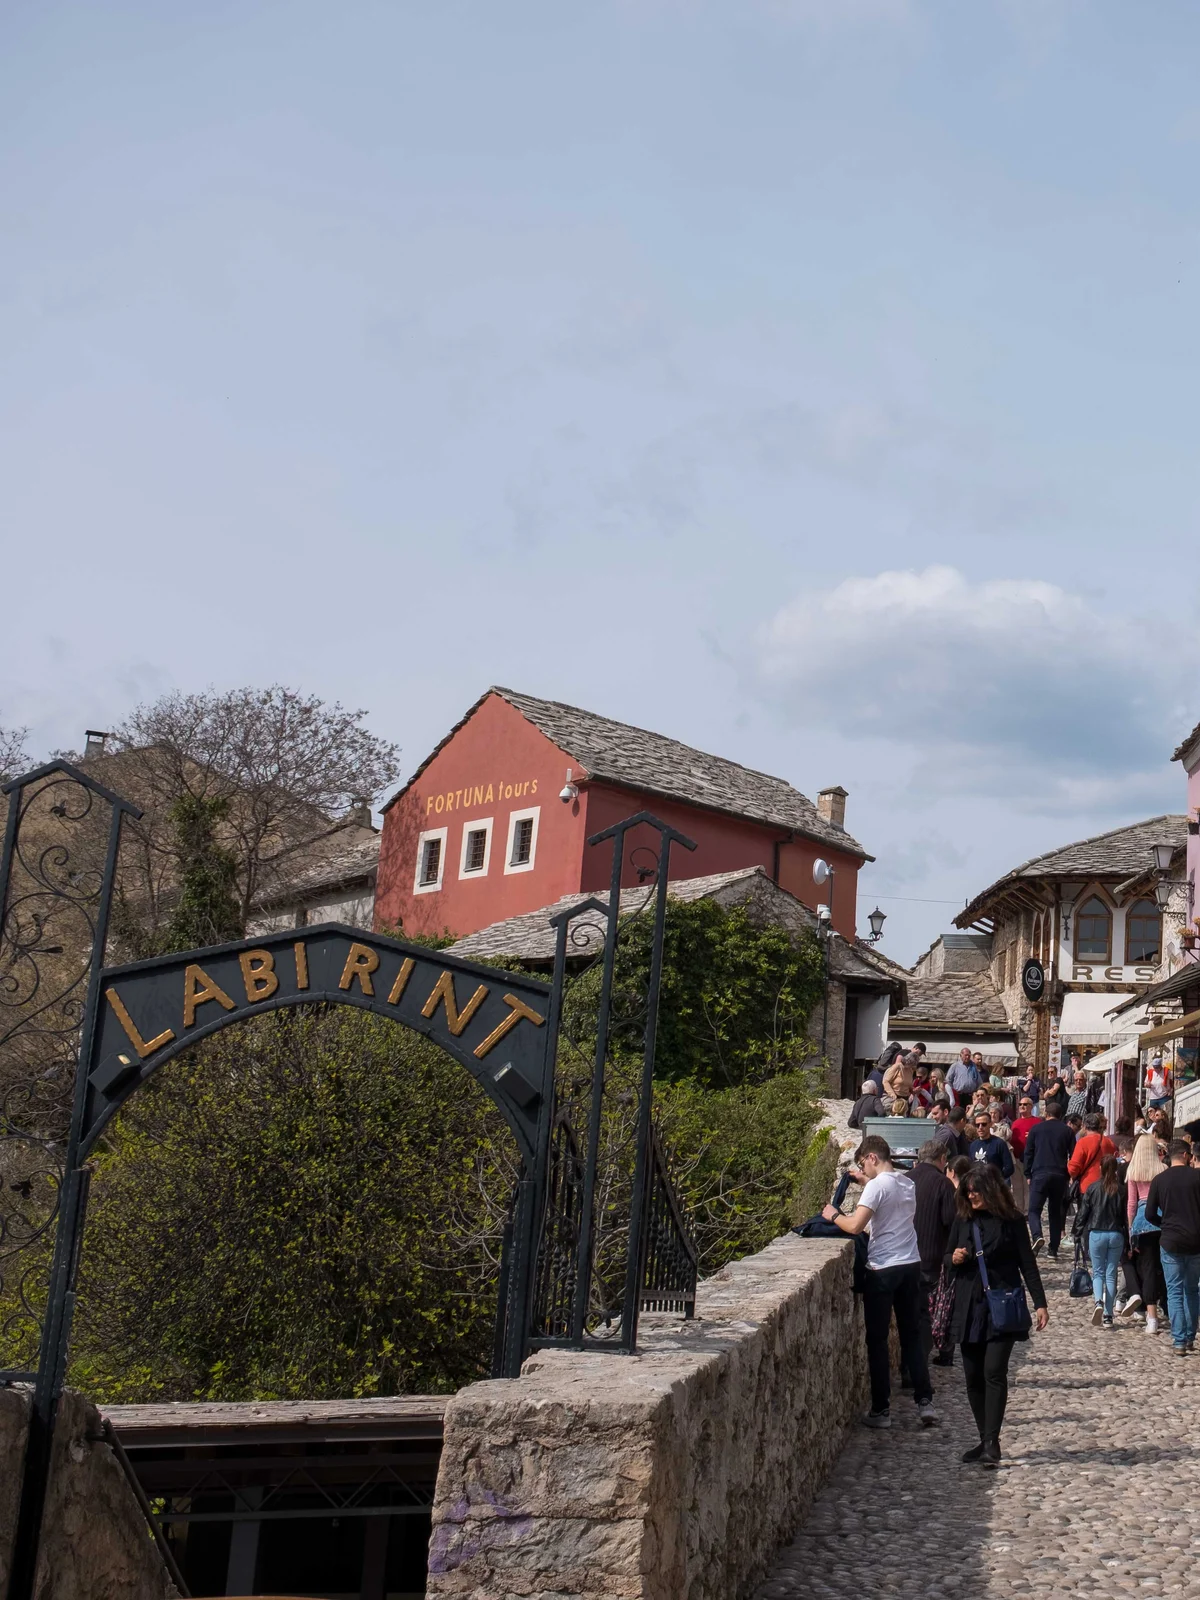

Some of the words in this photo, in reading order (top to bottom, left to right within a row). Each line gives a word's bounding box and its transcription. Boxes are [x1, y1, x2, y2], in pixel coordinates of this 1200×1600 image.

[426, 783, 494, 816] FORTUNA
[498, 779, 538, 801] tours
[105, 941, 546, 1059] LABIRINT
